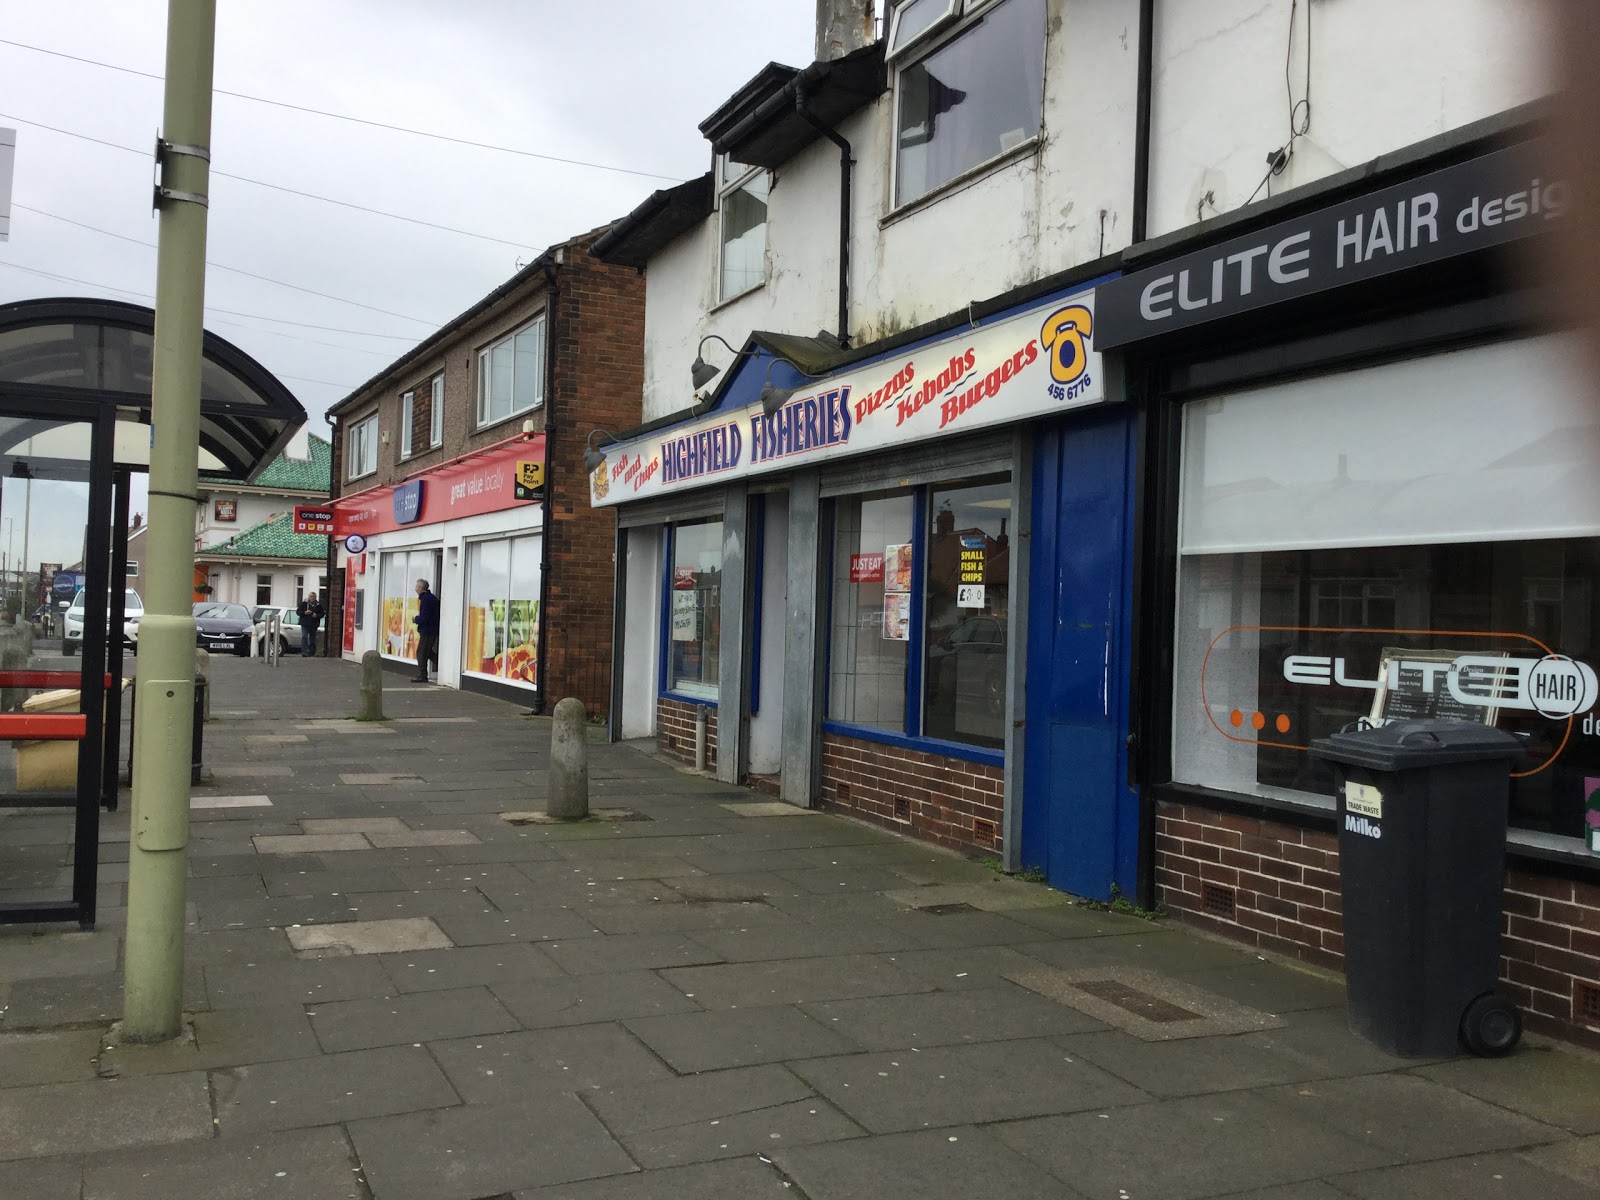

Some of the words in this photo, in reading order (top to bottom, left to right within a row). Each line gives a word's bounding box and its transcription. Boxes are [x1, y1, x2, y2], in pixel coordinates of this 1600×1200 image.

[1140, 231, 1310, 321] ELITE
[1336, 192, 1439, 269] HAIR
[1456, 178, 1568, 234] desig
[854, 361, 915, 425] Pizzas
[896, 347, 976, 427] Kebabs
[939, 339, 1038, 429] Burgers
[1047, 384, 1065, 401] 456
[1067, 373, 1092, 401] 6776
[661, 421, 742, 486] HIGHFIELD
[750, 385, 853, 465] FISHERIES
[612, 454, 629, 484] Fish
[624, 454, 642, 484] and
[633, 457, 659, 493] Chips
[450, 480, 466, 506] great
[467, 474, 484, 496] value
[484, 466, 505, 493] locally
[315, 512, 331, 521] stop
[852, 558, 868, 571] JUST
[868, 557, 882, 570] EAT
[961, 551, 984, 560] SMALL
[961, 562, 976, 571] FISH
[977, 562, 984, 571] &
[961, 573, 983, 582] CHIPS
[1283, 655, 1522, 708] ELITE
[1536, 673, 1577, 702] HAIR
[1348, 801, 1362, 812] TRADE
[1363, 805, 1379, 816] WASTE
[1345, 814, 1382, 839] Milko
